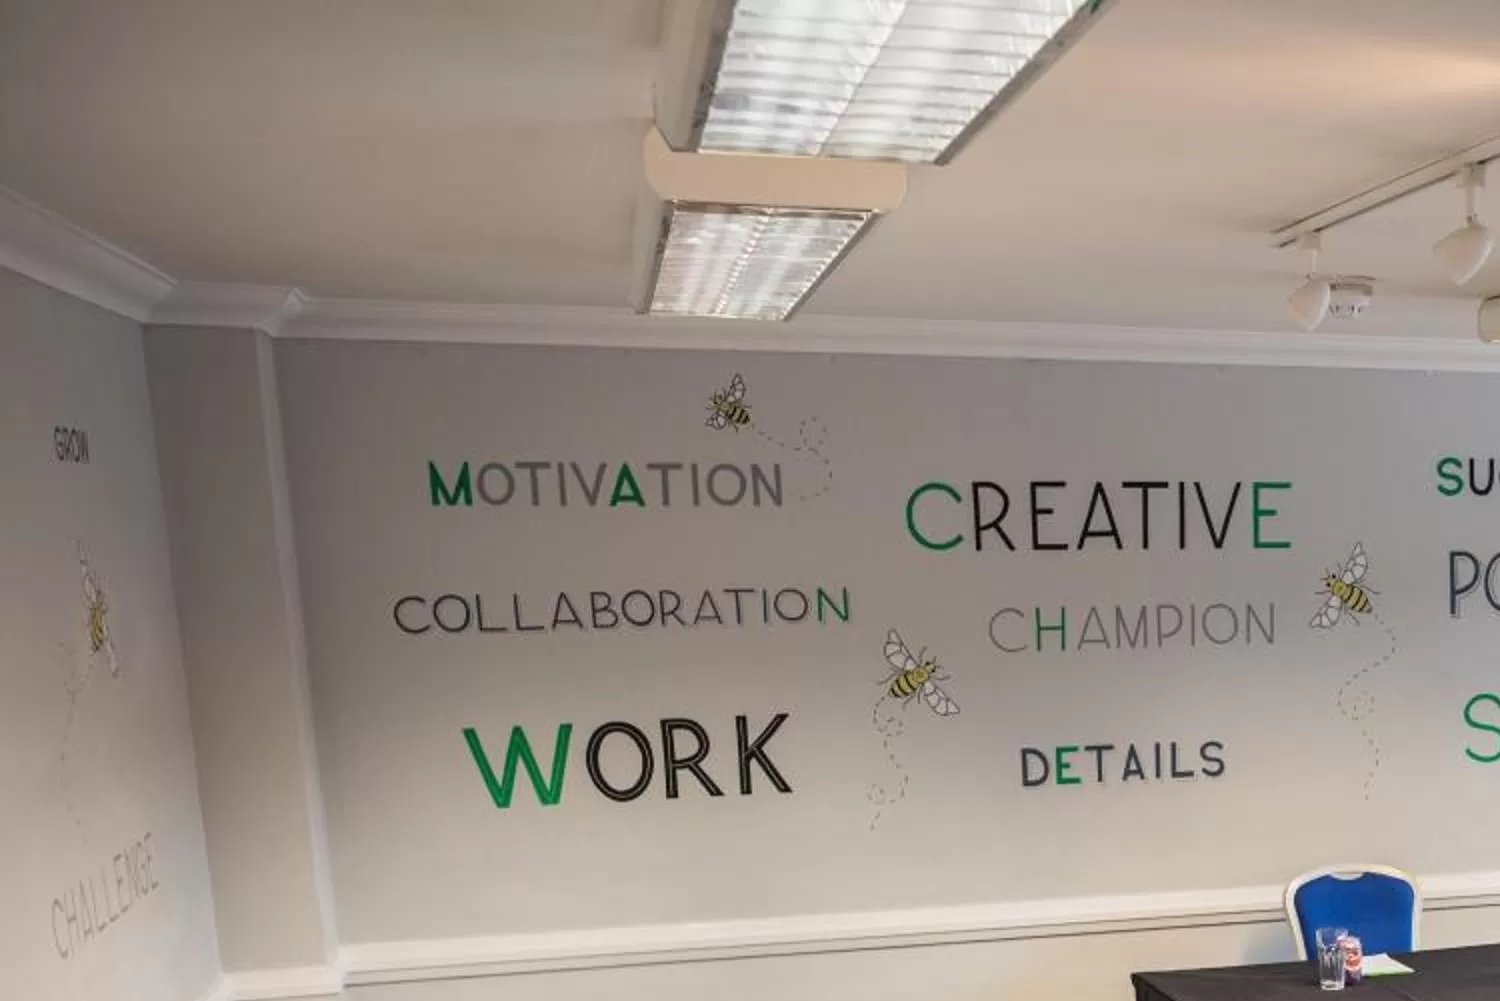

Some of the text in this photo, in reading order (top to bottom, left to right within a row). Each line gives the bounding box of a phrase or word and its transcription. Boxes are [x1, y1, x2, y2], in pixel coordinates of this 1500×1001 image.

[428, 460, 782, 508] MOTIVATION
[904, 480, 1293, 552] CREATIVE
[394, 586, 851, 635] COLLABORATION
[989, 603, 1274, 653] CHAMPION
[461, 713, 793, 809] WORK
[1020, 740, 1226, 788] DETAILS
[53, 832, 159, 959] CHALLENGE
